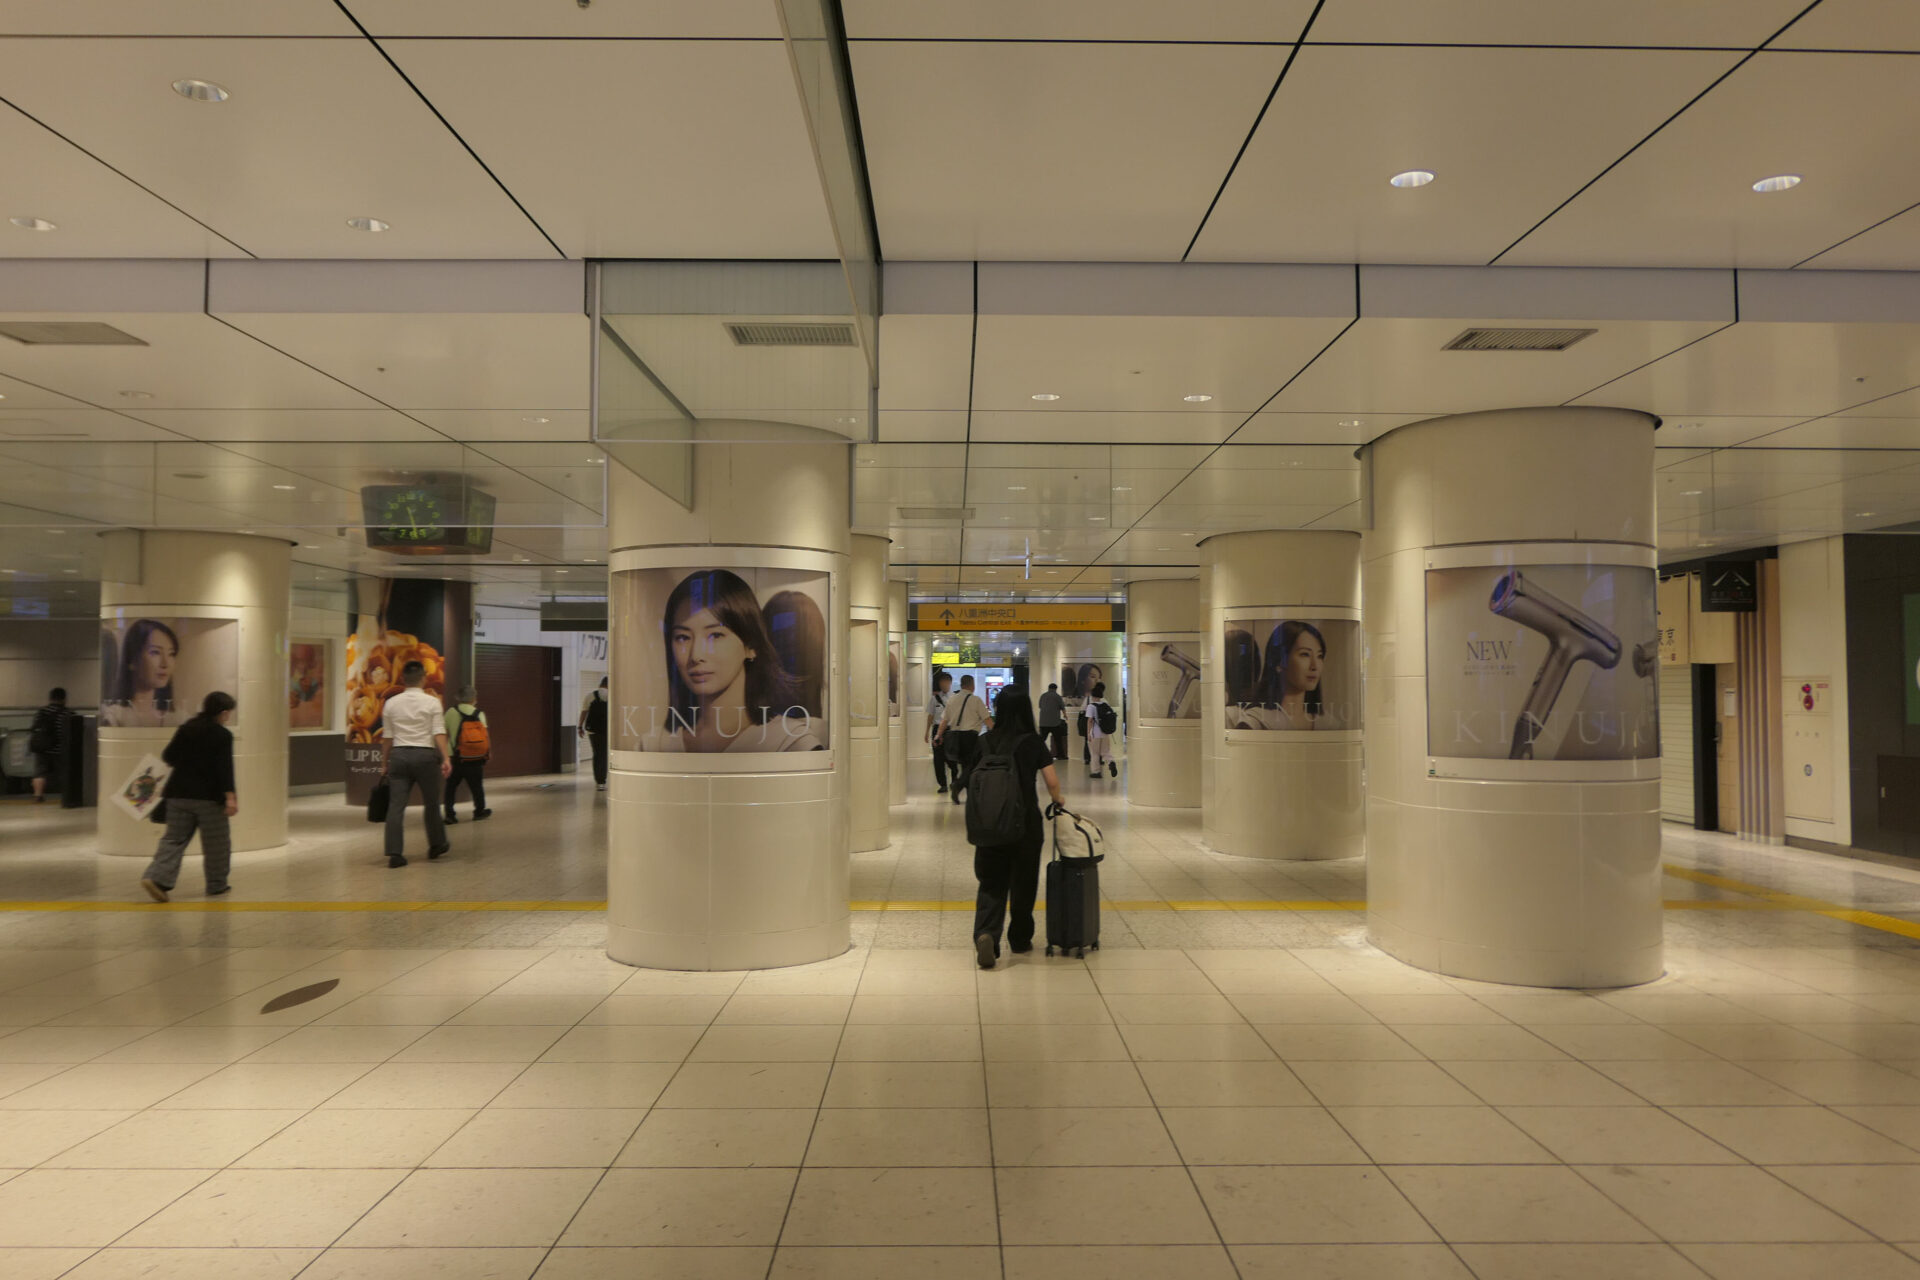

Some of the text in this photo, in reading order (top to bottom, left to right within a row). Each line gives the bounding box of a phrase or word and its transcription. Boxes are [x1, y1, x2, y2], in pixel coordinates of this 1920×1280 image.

[959, 608, 1016, 618] 八重洲中央口
[1466, 640, 1512, 660] NEW
[1236, 701, 1355, 724] KINUJO
[621, 705, 811, 745] KINUJO
